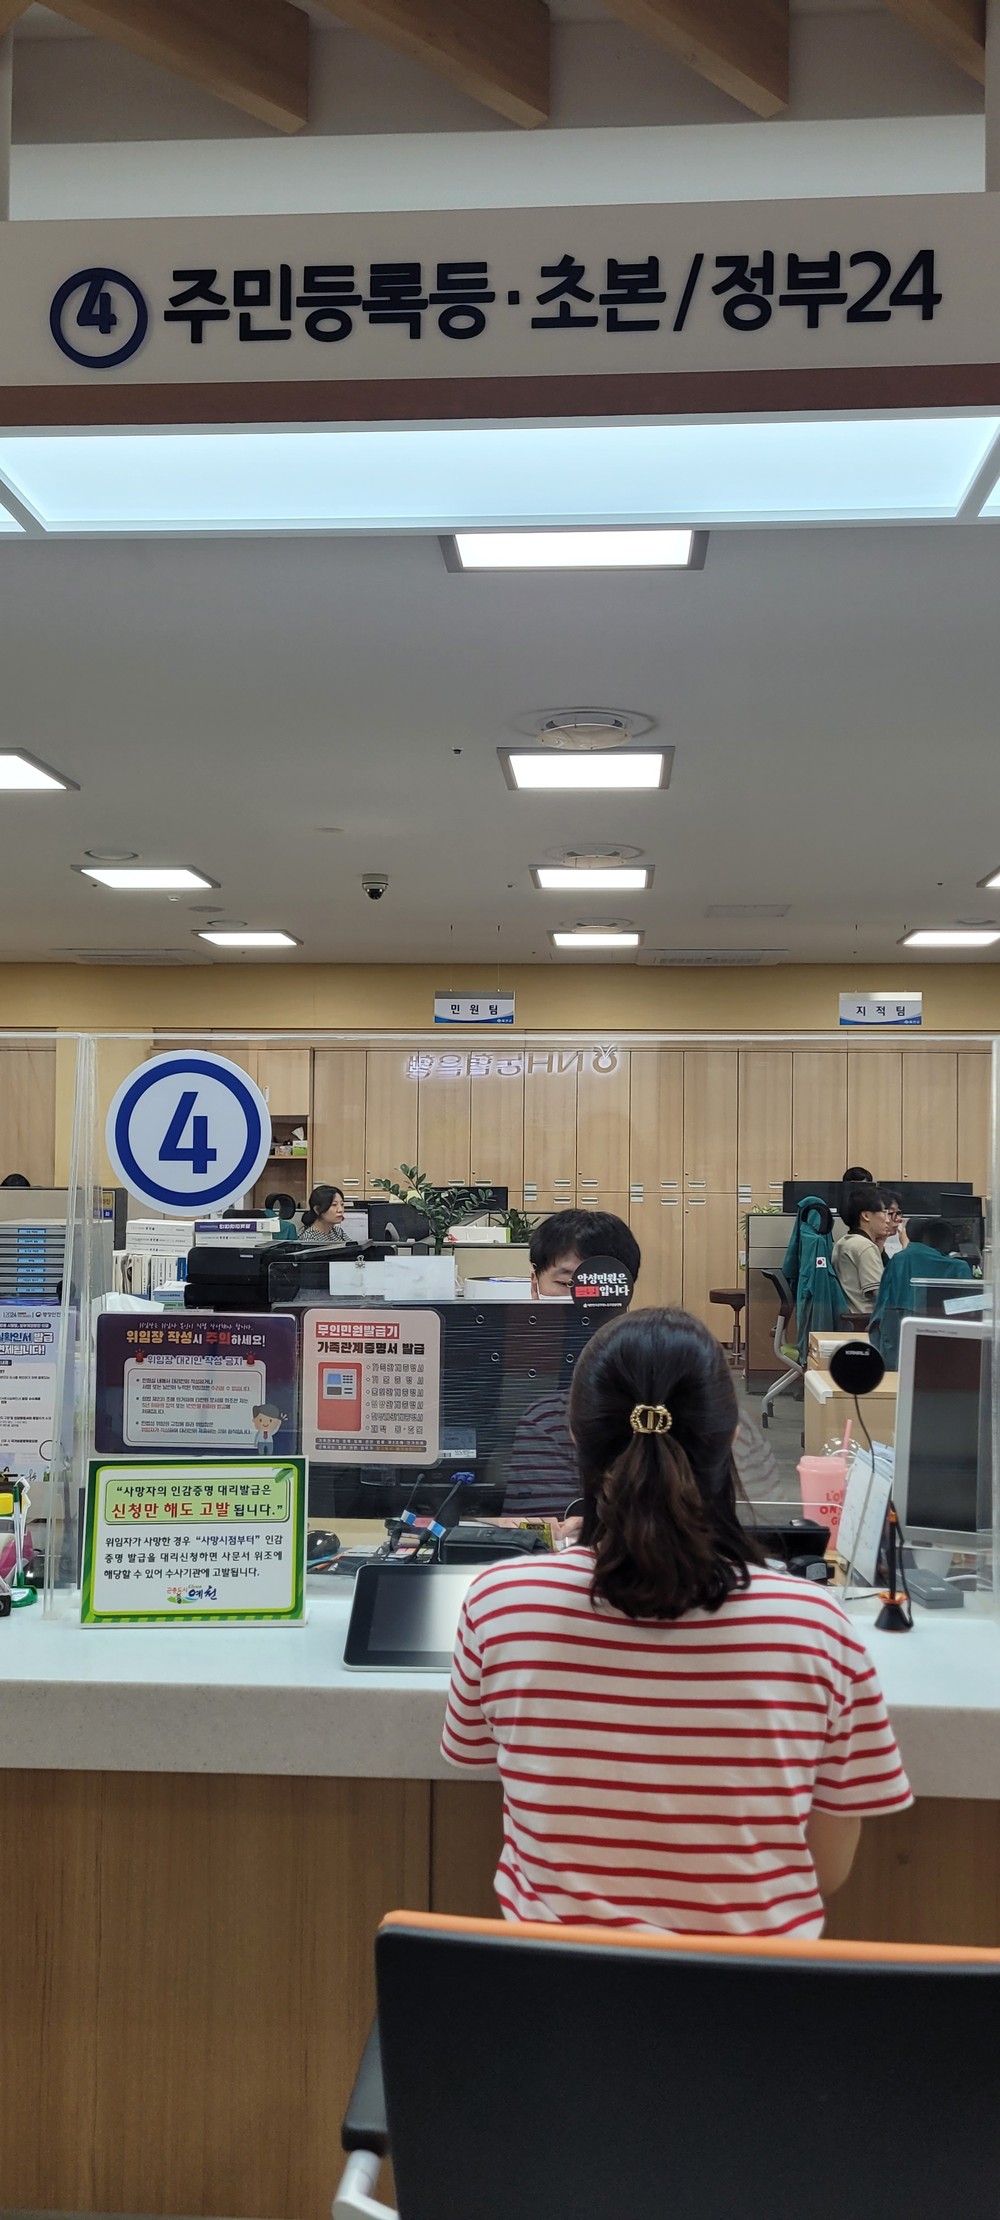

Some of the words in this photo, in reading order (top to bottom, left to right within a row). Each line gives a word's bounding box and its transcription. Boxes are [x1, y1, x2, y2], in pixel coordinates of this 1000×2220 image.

[158, 1091, 217, 1174] 4
[577, 1273, 628, 1285] 악성민원은
[318, 1324, 397, 1337] 무인민원발급기
[33, 1332, 54, 1343] 발급
[126, 1331, 163, 1343] 위임장
[168, 1332, 202, 1345] 작성시
[206, 1332, 266, 1347] 주의하세요!
[317, 1342, 397, 1354] 가족관계증명서
[402, 1343, 424, 1355] 발급
[147, 1356, 172, 1364] 위임장
[177, 1356, 202, 1365] 대리인
[205, 1356, 222, 1365] 작성
[226, 1357, 242, 1366] 금지
[171, 1485, 213, 1496] 인감증명
[218, 1485, 272, 1496] 대리발급은
[112, 1503, 158, 1519] 신청만
[164, 1503, 193, 1518] 해도
[200, 1502, 230, 1517] 고발
[106, 1537, 141, 1547] 위임자가
[144, 1537, 170, 1547] 사망한
[173, 1537, 190, 1546] 경우
[265, 1535, 283, 1545] 인감
[105, 1554, 123, 1563] 증명
[127, 1553, 156, 1563] 발급을
[161, 1552, 217, 1563] 대리신청하면
[222, 1552, 250, 1561] 사문서
[254, 1551, 282, 1561] 위조에
[104, 1570, 131, 1579] 해당할
[134, 1569, 142, 1579] 수
[145, 1569, 162, 1578] 있어
[165, 1568, 210, 1578] 수사기관에
[213, 1567, 259, 1577] 고발됩니다.
[188, 1585, 217, 1600] 예천
